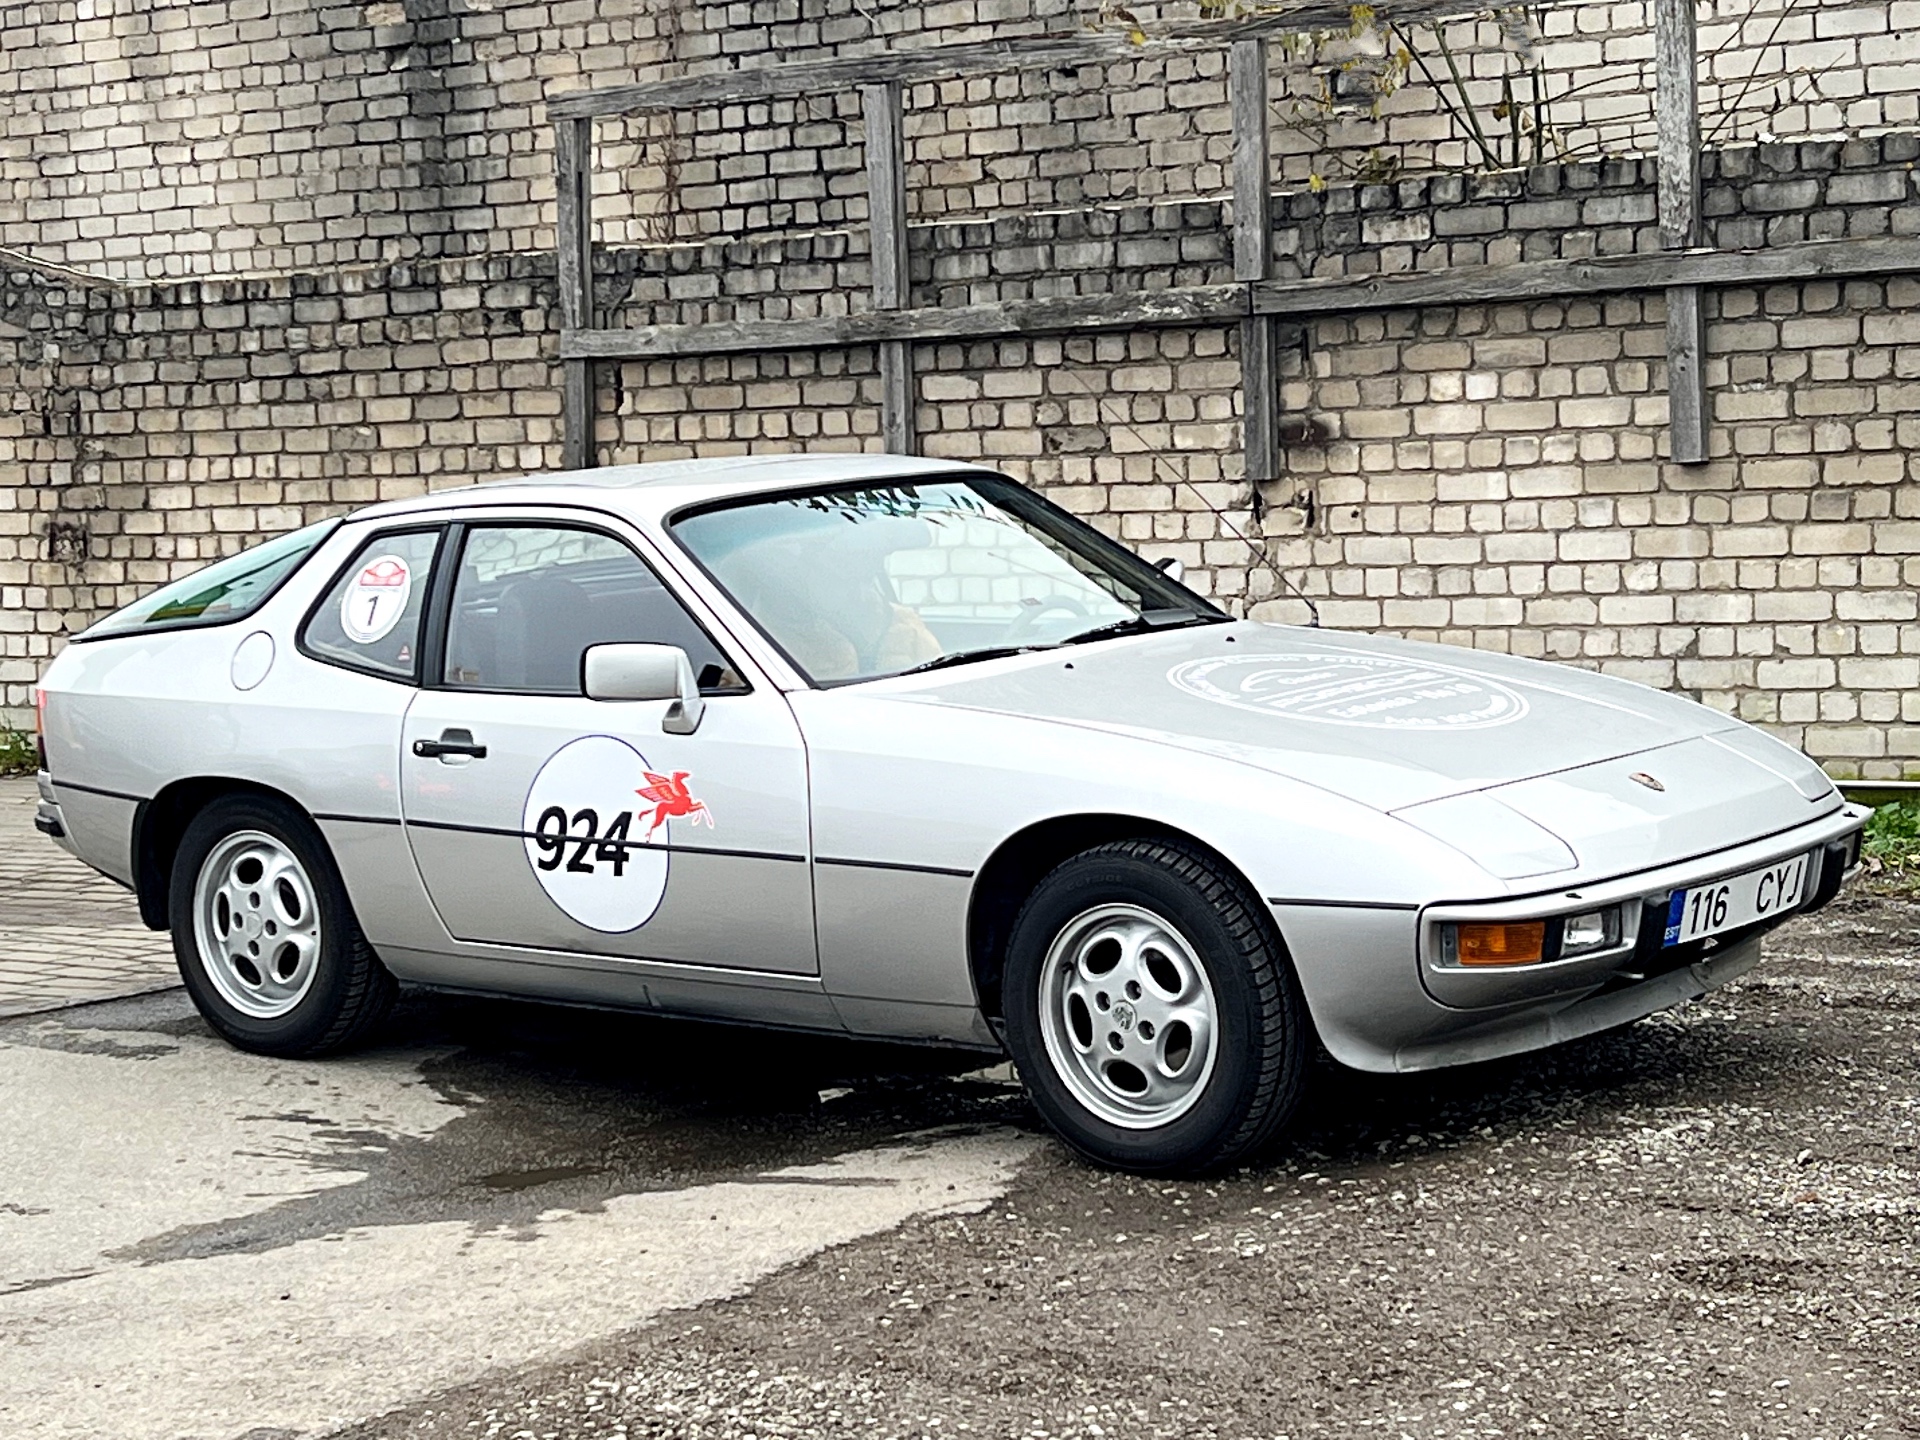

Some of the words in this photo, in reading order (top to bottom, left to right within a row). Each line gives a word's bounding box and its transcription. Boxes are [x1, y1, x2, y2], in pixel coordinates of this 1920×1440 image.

[367, 595, 379, 626] 1
[1268, 671, 1445, 708] PORSCHE
[535, 805, 632, 877] 924
[1690, 885, 1730, 935] 116
[1756, 860, 1803, 914] CYJ
[1664, 925, 1680, 940] EST
